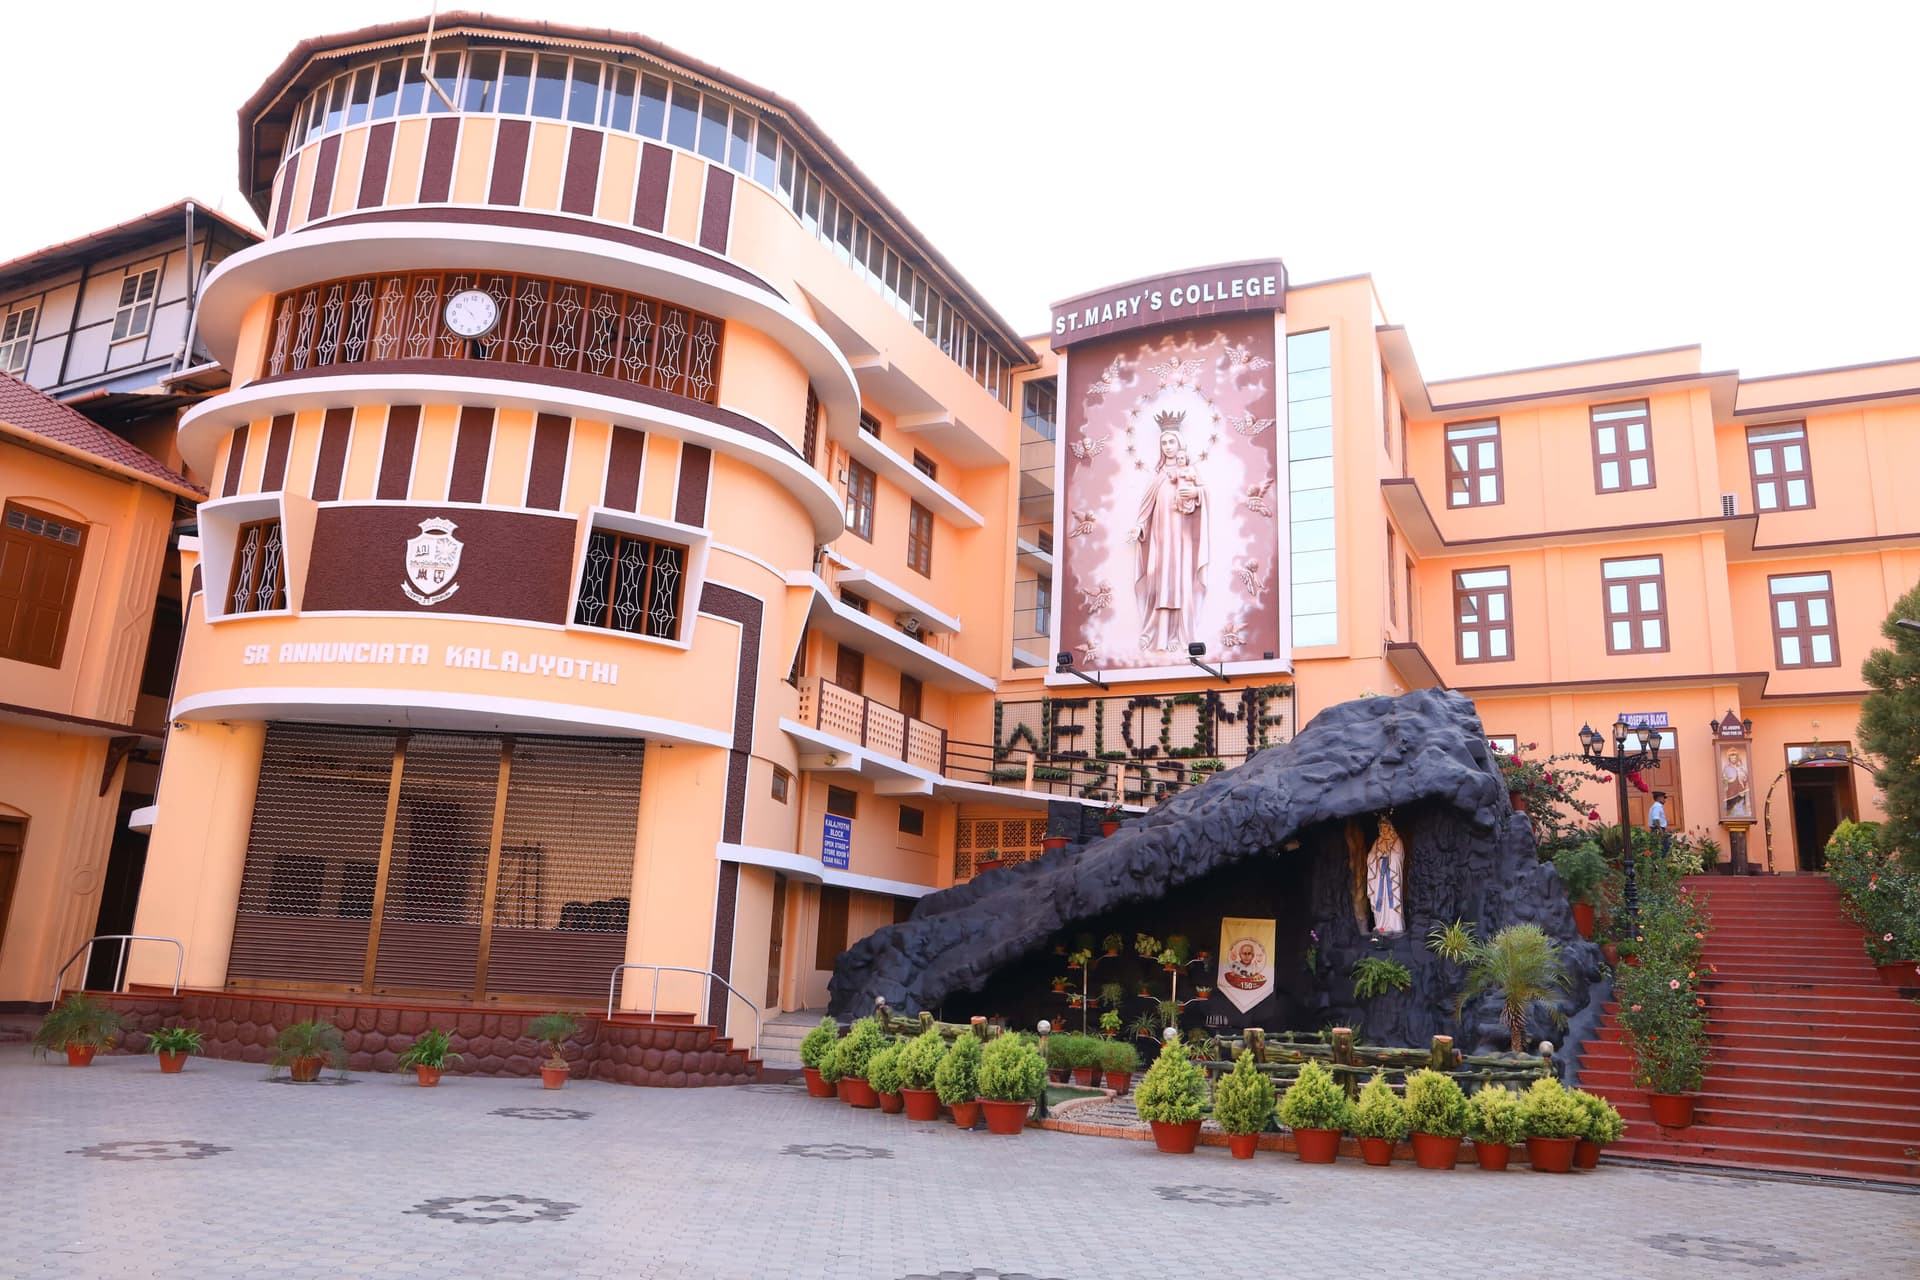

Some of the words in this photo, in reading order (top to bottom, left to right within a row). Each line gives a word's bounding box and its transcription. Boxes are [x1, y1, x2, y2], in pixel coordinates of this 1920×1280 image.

[1169, 276, 1276, 307] COLLEGE
[243, 644, 270, 665] SR
[278, 642, 429, 665] ANNUNCIATA
[444, 645, 619, 685] KALAJYOTHI
[994, 684, 1293, 762] WELCOME
[830, 828, 844, 838] BLOCK
